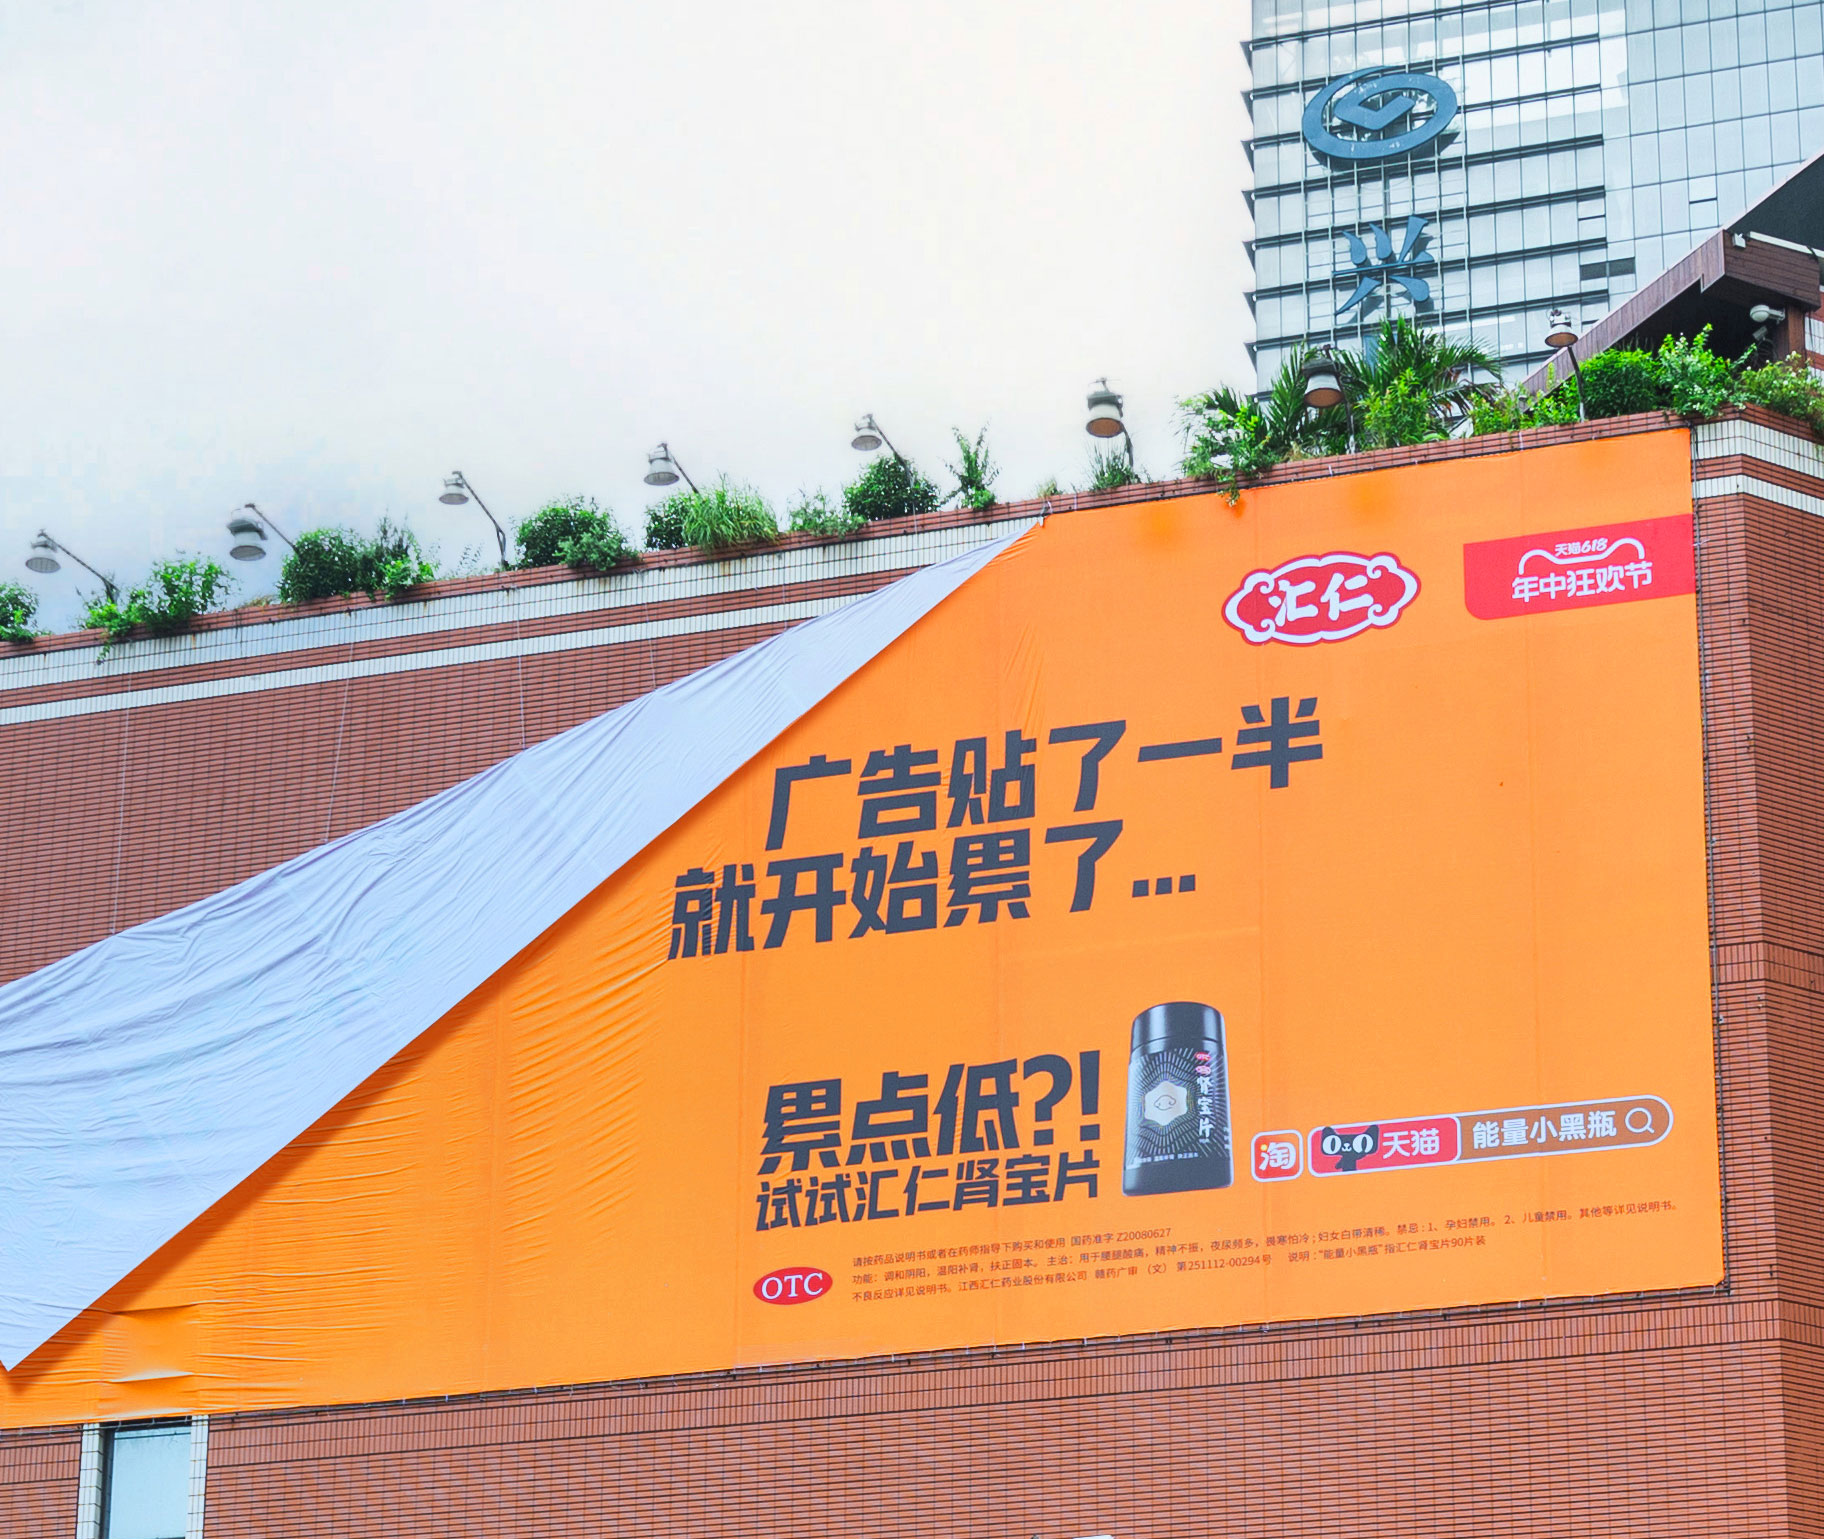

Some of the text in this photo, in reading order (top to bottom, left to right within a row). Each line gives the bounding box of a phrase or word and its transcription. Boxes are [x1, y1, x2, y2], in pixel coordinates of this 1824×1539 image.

[1554, 538, 1609, 557] 天猫618
[1269, 572, 1374, 626] 汇仁
[1511, 561, 1653, 602] 年中狂欢节
[765, 696, 1323, 851] 广告贴了一半
[1382, 1127, 1441, 1160] 天猫
[1473, 1110, 1617, 1150] 能量小黑瓶
[1259, 1142, 1297, 1171] 淘
[755, 1149, 1101, 1232] 试试汇仁肾宝片
[1116, 1227, 1172, 1243] Z20080627
[761, 1272, 823, 1300] OTC
